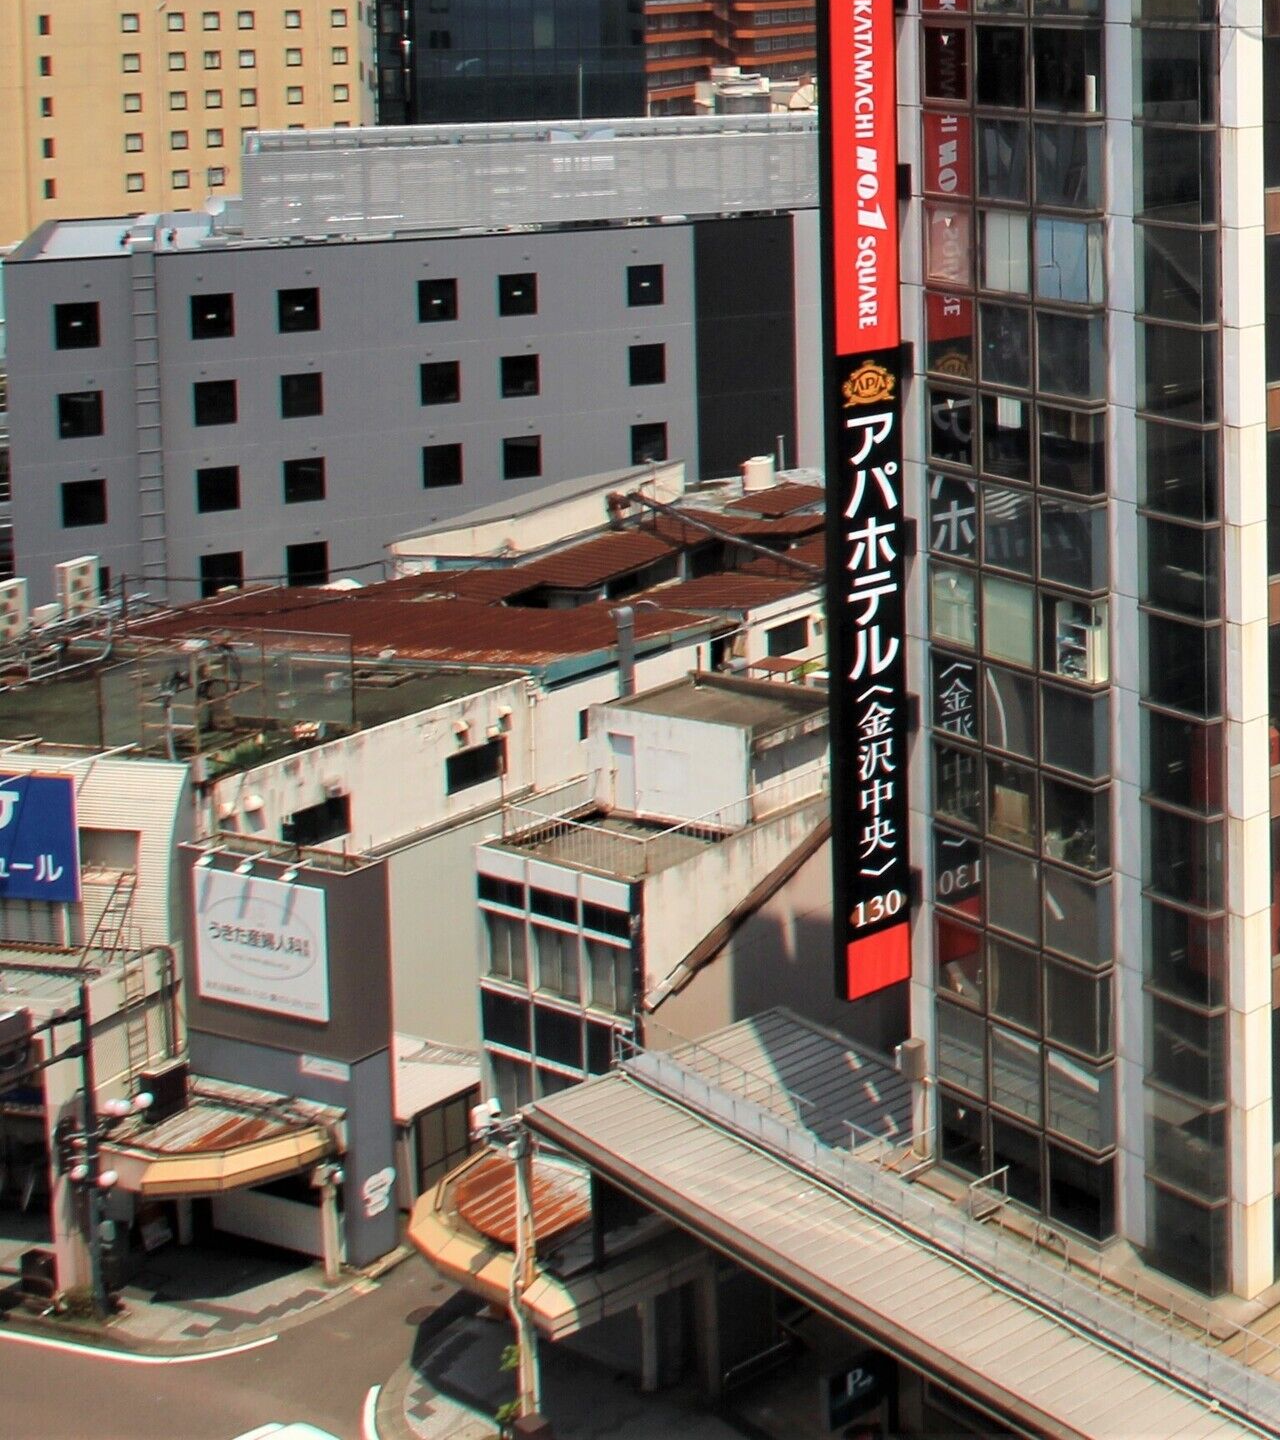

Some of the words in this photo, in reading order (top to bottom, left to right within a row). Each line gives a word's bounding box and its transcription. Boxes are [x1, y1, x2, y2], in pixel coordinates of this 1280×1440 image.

[853, 0, 874, 139] KATAMACHI
[856, 145, 888, 231] NO.1
[856, 235, 878, 330] SQUARE
[855, 889, 901, 927] 130
